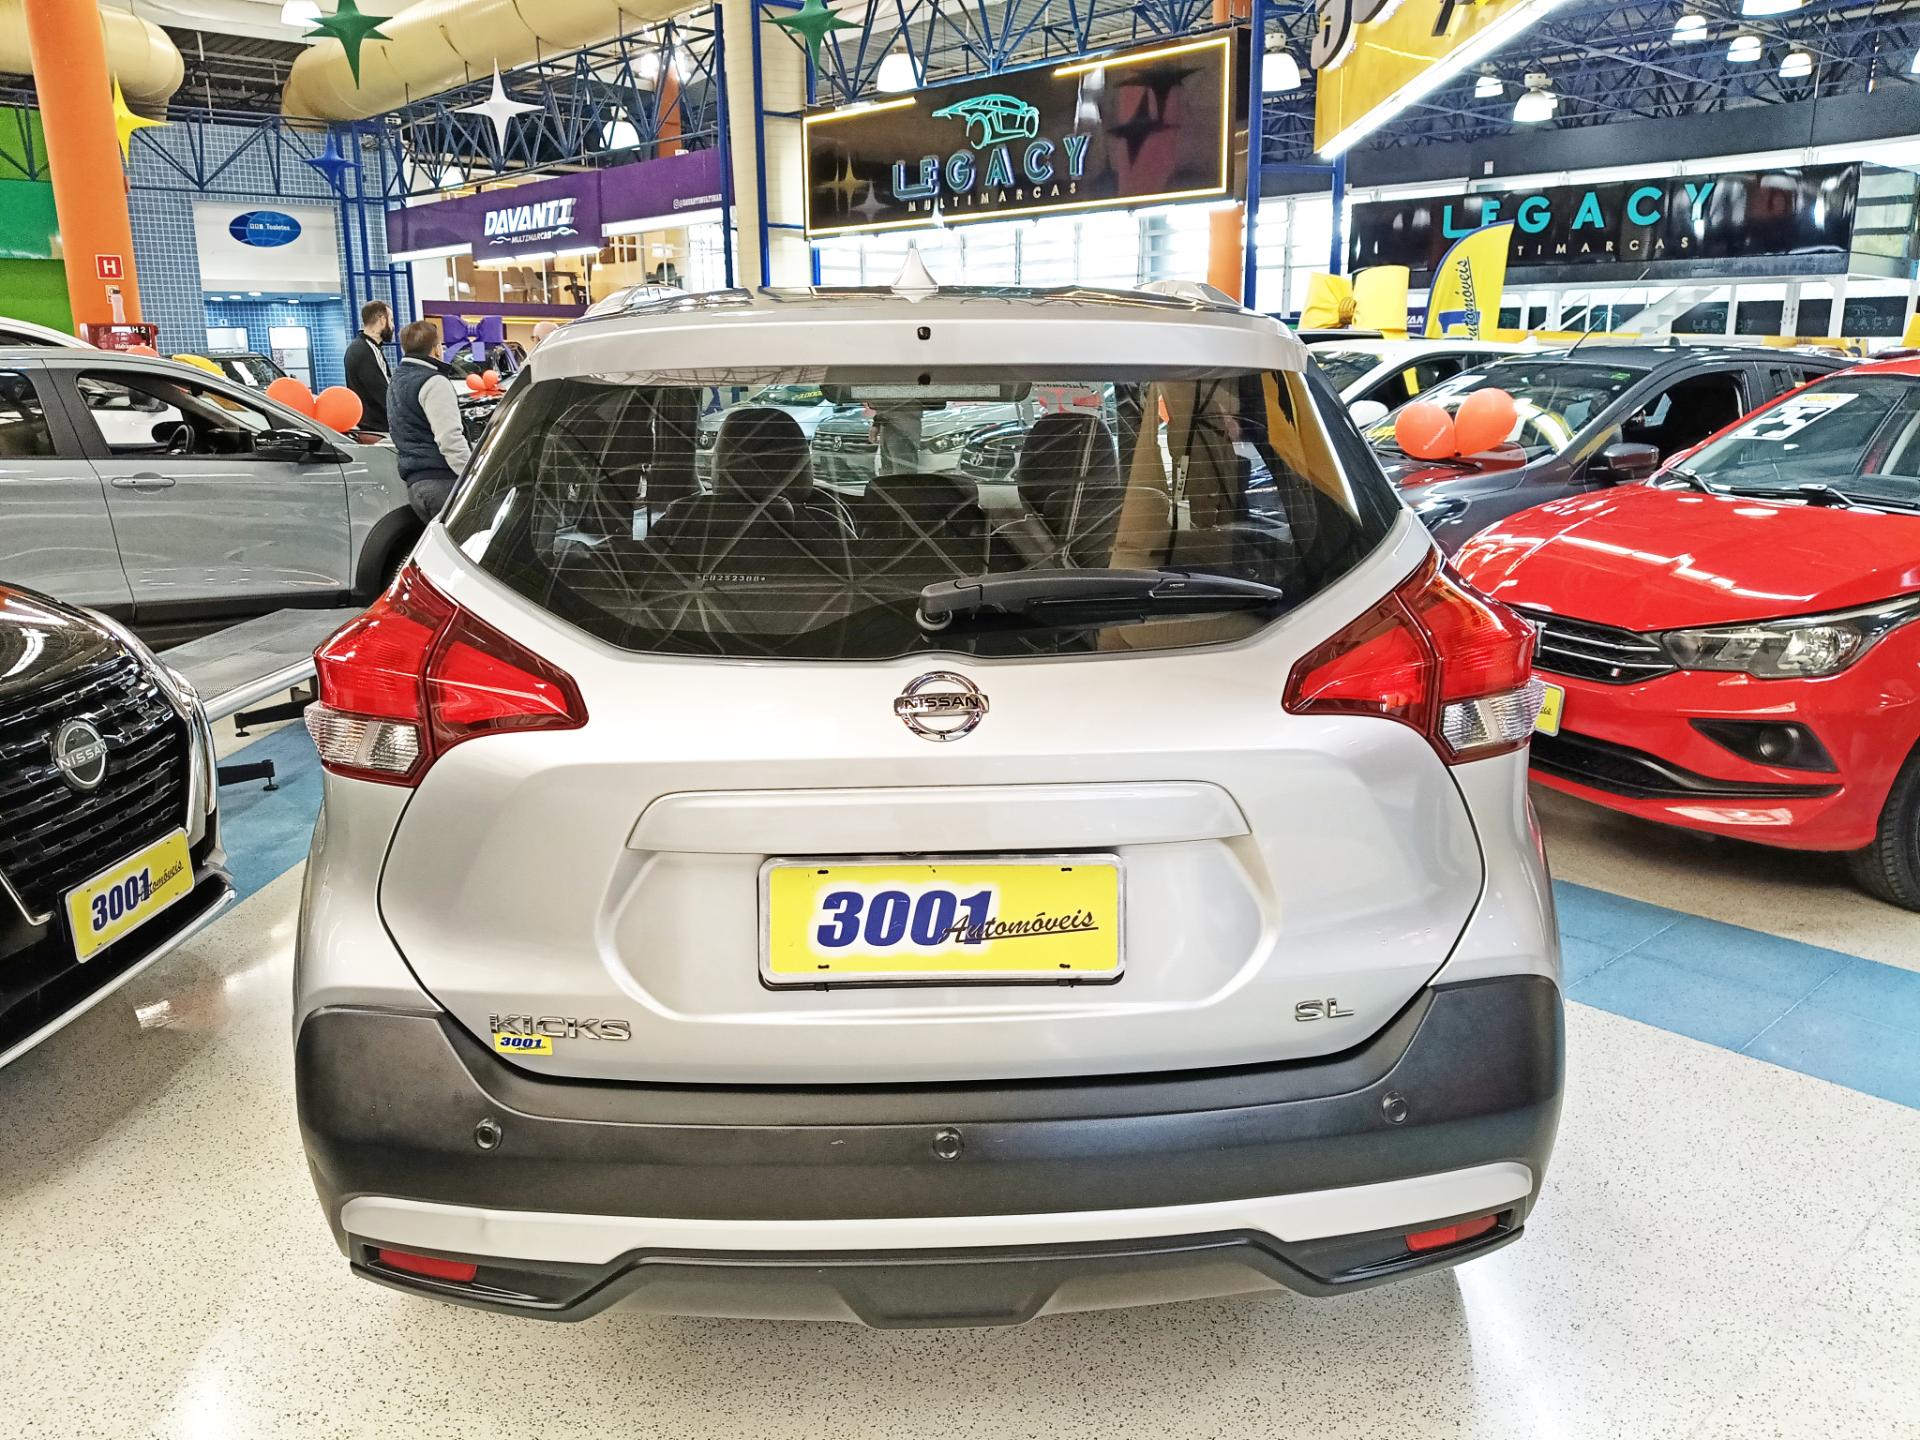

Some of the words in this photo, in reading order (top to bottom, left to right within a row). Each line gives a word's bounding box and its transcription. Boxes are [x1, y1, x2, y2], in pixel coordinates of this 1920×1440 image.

[892, 134, 1091, 199] LEGACY
[908, 182, 1077, 212] MULTIMARCAS
[1442, 182, 1715, 239] LEGACY
[484, 198, 577, 236] DAVANTI
[1517, 236, 1690, 257] TIMARCAS
[103, 259, 117, 274] H
[1456, 256, 1479, 340] utomóveis
[904, 696, 979, 709] NISSAN
[59, 741, 107, 771] NISSAN
[92, 867, 150, 931] 3001
[816, 889, 993, 948] 3001
[938, 909, 1099, 943] Automóveis
[1295, 998, 1355, 1022] SL
[489, 1013, 632, 1041] KICKS
[500, 1036, 542, 1049] 3001
